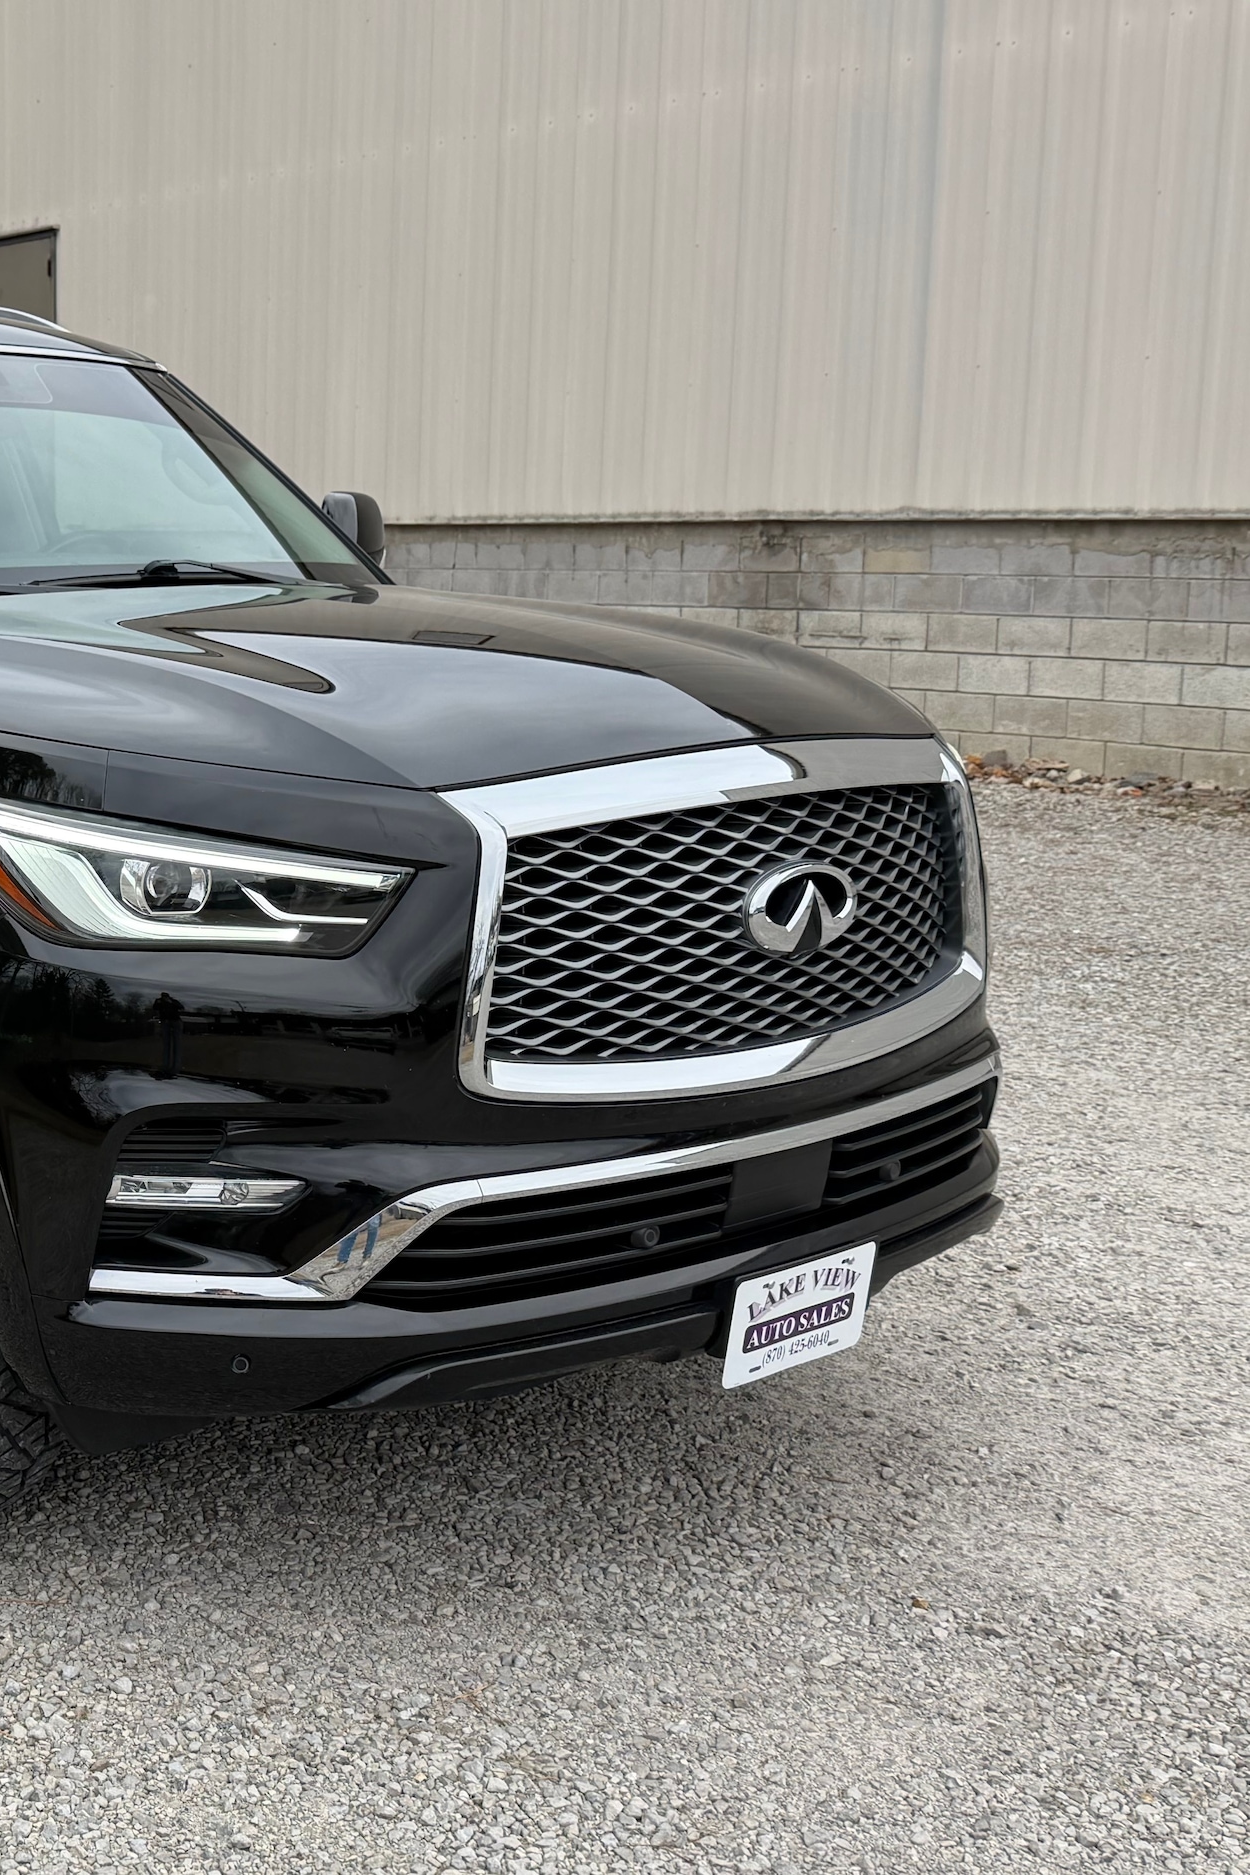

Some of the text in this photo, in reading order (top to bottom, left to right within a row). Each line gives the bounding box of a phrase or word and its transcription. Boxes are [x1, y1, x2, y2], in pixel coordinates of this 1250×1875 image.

[747, 1267, 861, 1322] LAKE VIEW
[747, 1298, 850, 1349] AUTO SALES
[762, 1345, 786, 1368] (870)
